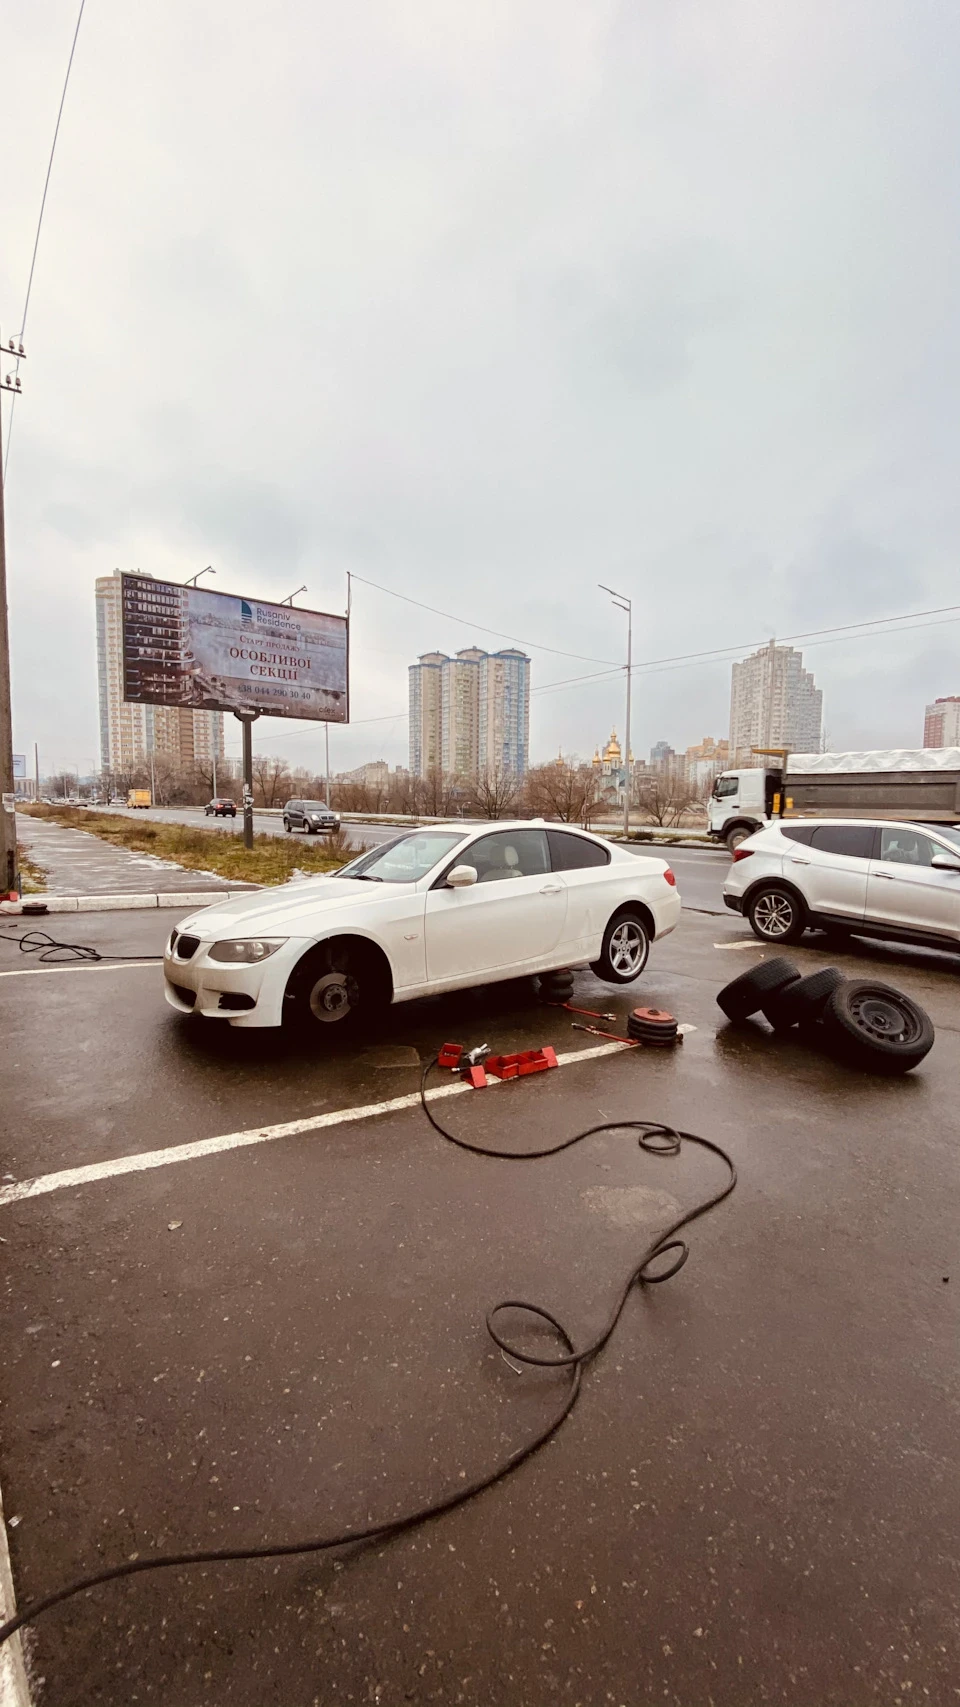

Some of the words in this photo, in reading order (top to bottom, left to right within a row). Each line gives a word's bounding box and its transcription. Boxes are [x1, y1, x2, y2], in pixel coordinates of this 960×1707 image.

[256, 607, 291, 621] Rusaniv
[256, 615, 301, 631] Residence
[229, 647, 312, 669] ОСОБЛИВОЇ
[250, 664, 298, 680] СЕКЦІЇ
[254, 686, 270, 695] 044
[273, 688, 288, 697] 290
[290, 690, 299, 699] 30
[302, 692, 311, 700] 40
